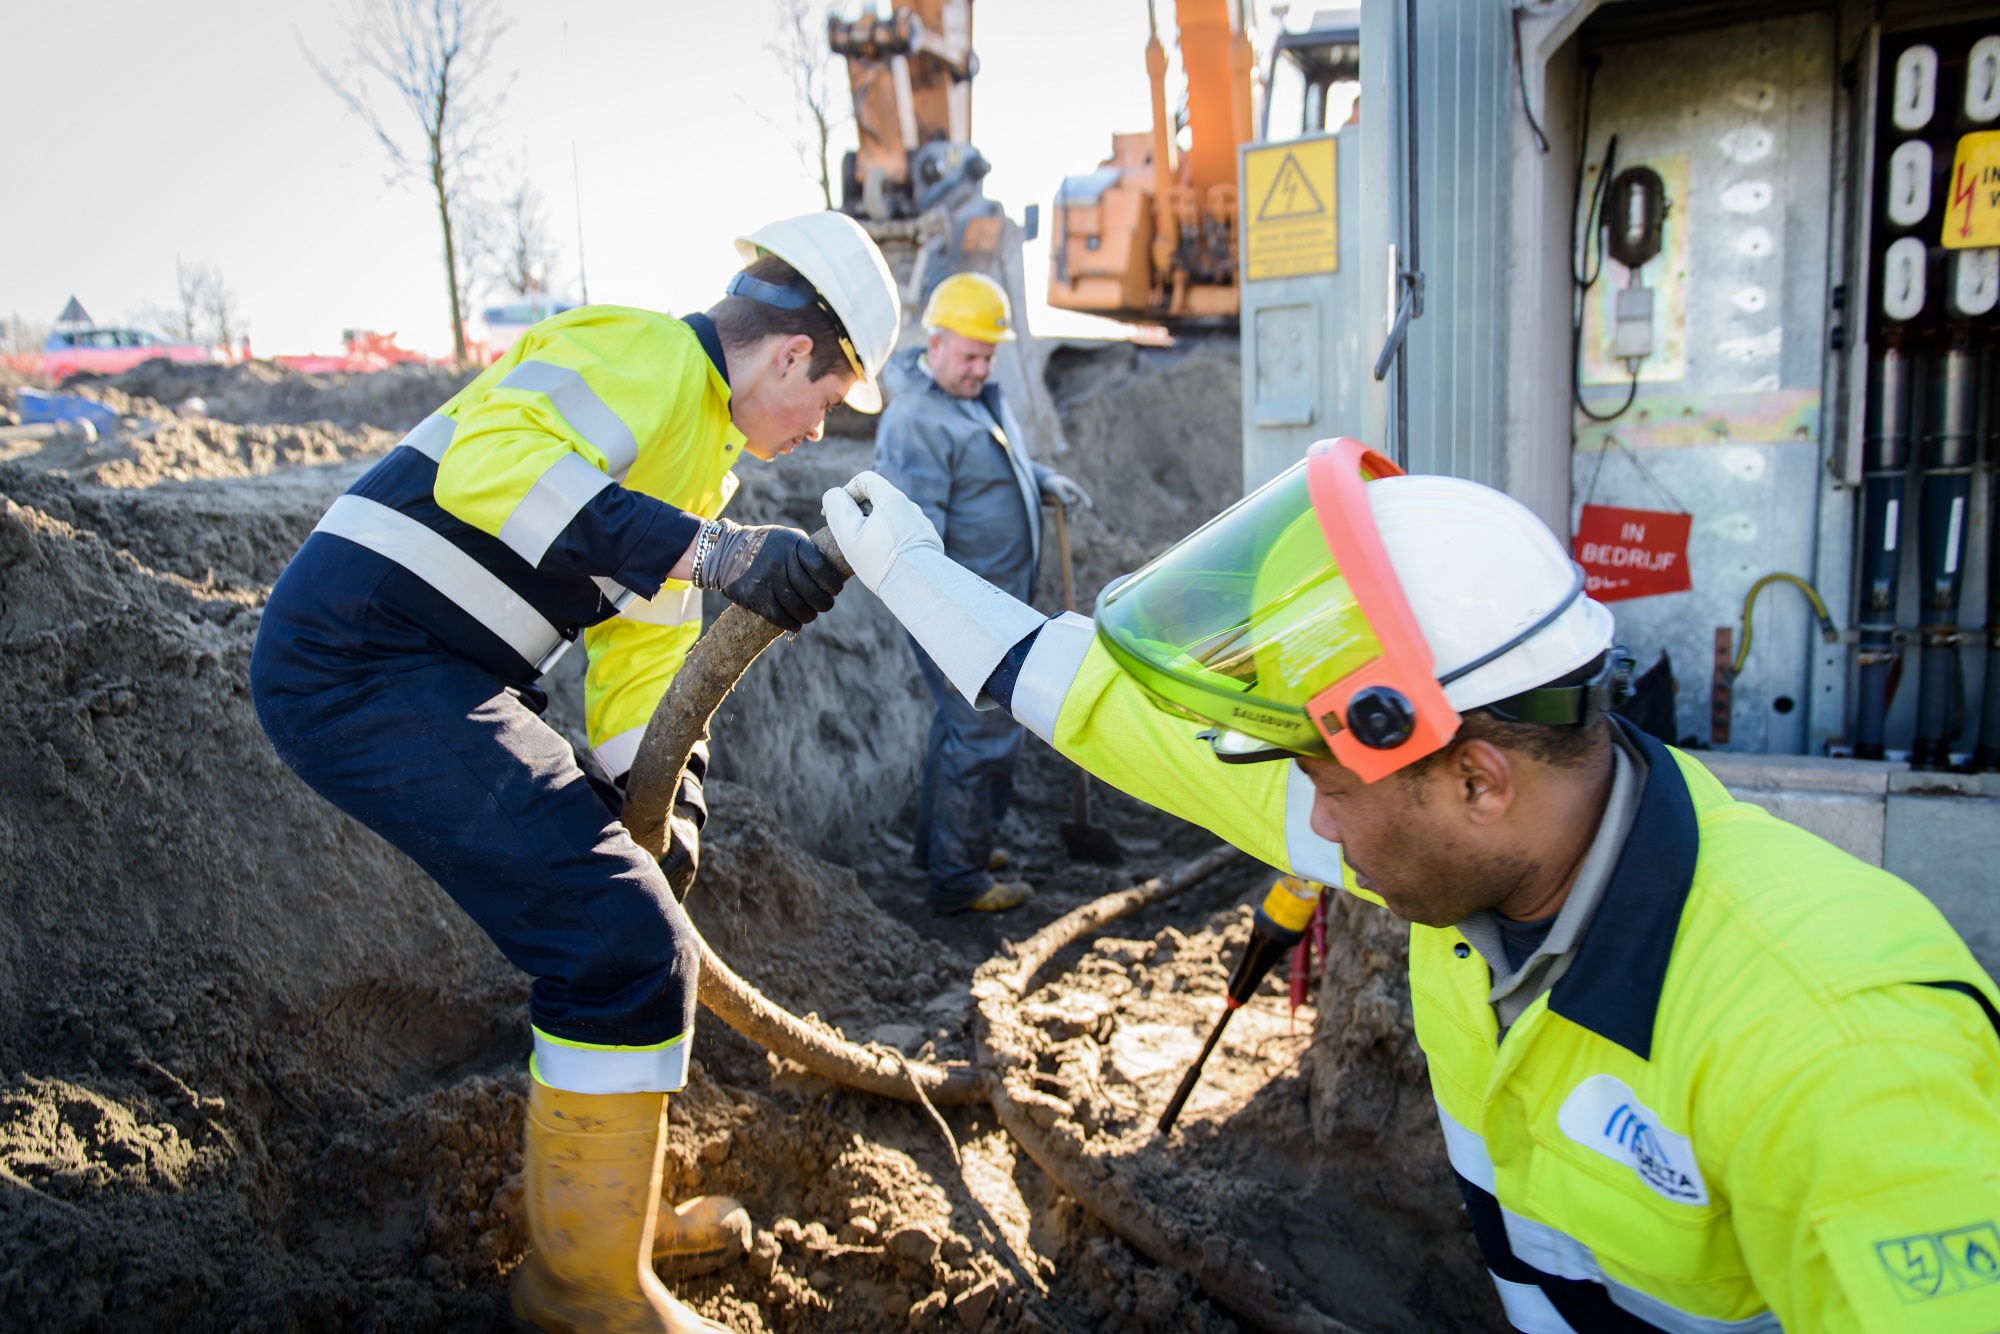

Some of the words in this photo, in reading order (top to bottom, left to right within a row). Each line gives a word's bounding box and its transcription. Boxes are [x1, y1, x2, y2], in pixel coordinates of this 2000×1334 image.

[1621, 522, 1645, 543] IN
[1581, 542, 1677, 571] BEDRIJF
[1232, 707, 1302, 731] SALISBURY
